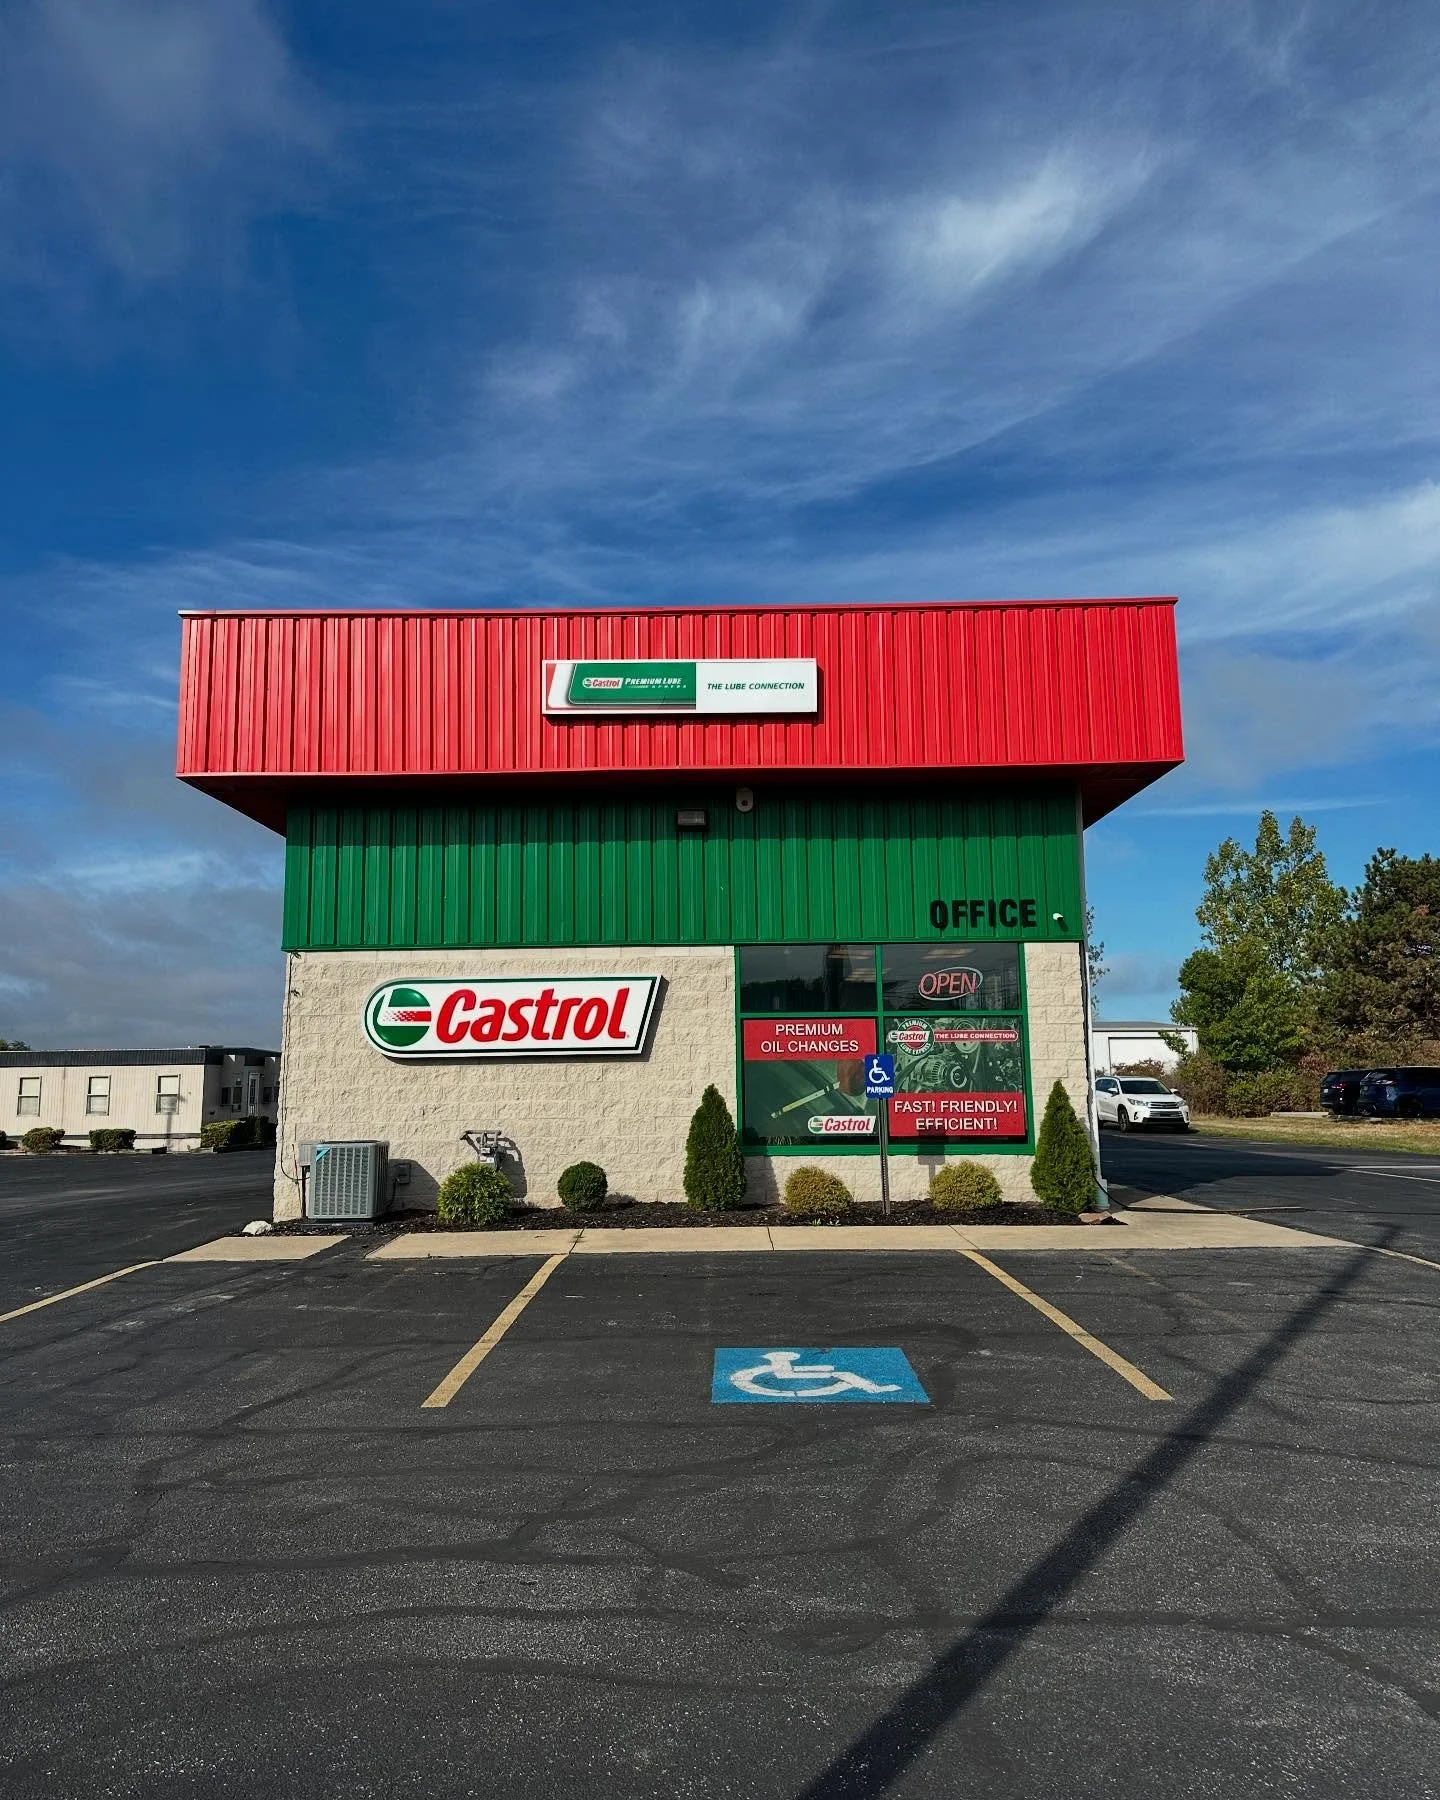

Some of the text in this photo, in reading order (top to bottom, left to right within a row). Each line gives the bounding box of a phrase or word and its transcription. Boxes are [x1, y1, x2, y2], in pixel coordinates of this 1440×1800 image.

[592, 679, 620, 688] Castrol
[748, 682, 805, 690] CONNECTION
[929, 899, 1037, 929] OFFICE
[919, 972, 978, 996] OPEN
[436, 987, 630, 1044] Castrol
[775, 1023, 843, 1036] PREMIUM
[899, 1032, 927, 1041] Castrol
[761, 1039, 859, 1053] OIL CHANGES
[866, 1086, 894, 1095] PARKING
[894, 1100, 1018, 1113] FAST! FRIENDLY!
[823, 1118, 872, 1132] Castrol
[916, 1117, 998, 1131] EFFICIENT!
